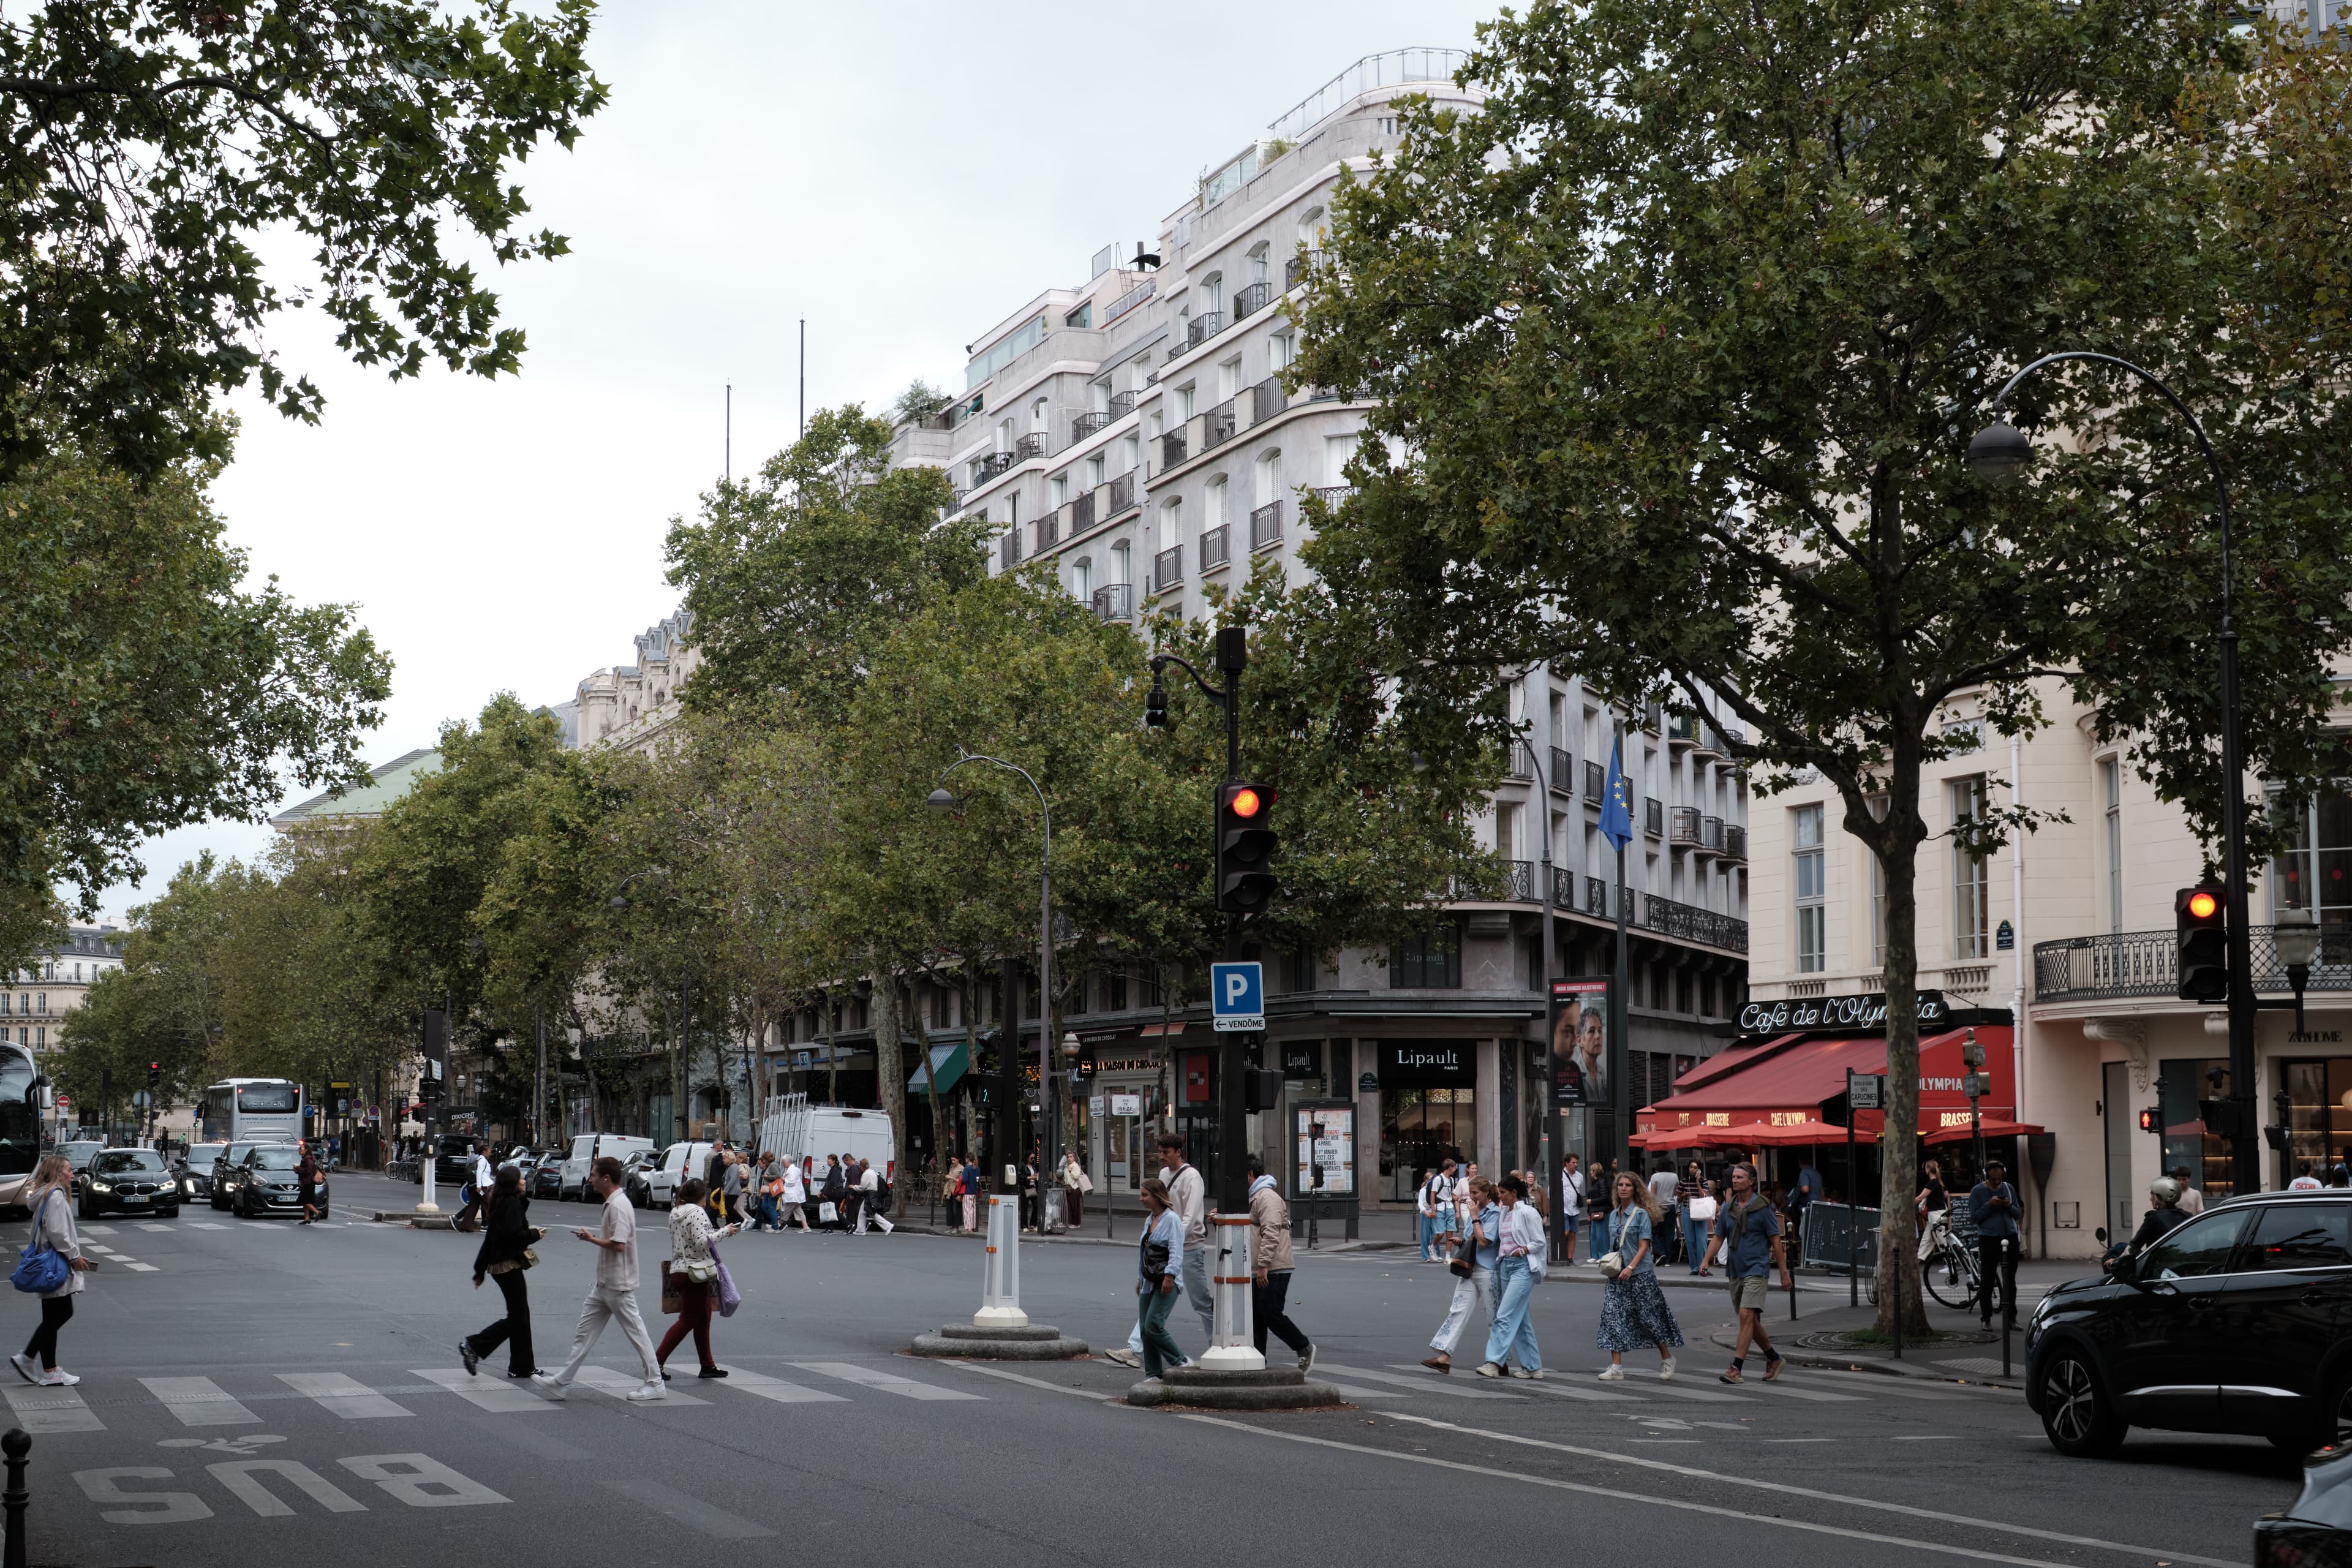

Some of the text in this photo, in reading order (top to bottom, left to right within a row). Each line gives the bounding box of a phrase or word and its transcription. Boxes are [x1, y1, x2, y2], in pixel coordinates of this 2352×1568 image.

[1226, 974, 1248, 1006] P
[1228, 1019, 1264, 1028] VENDÔME
[1741, 996, 1941, 1034] Café de l'Olymia
[1105, 1060, 1127, 1070] MAISON
[1288, 1051, 1311, 1069] Lipault
[1397, 1049, 1458, 1067] Lipault
[1679, 1112, 1806, 1126] CAFE BRASSERIE CAFE L'OLYMPIA
[72, 1452, 514, 1524] BUS
